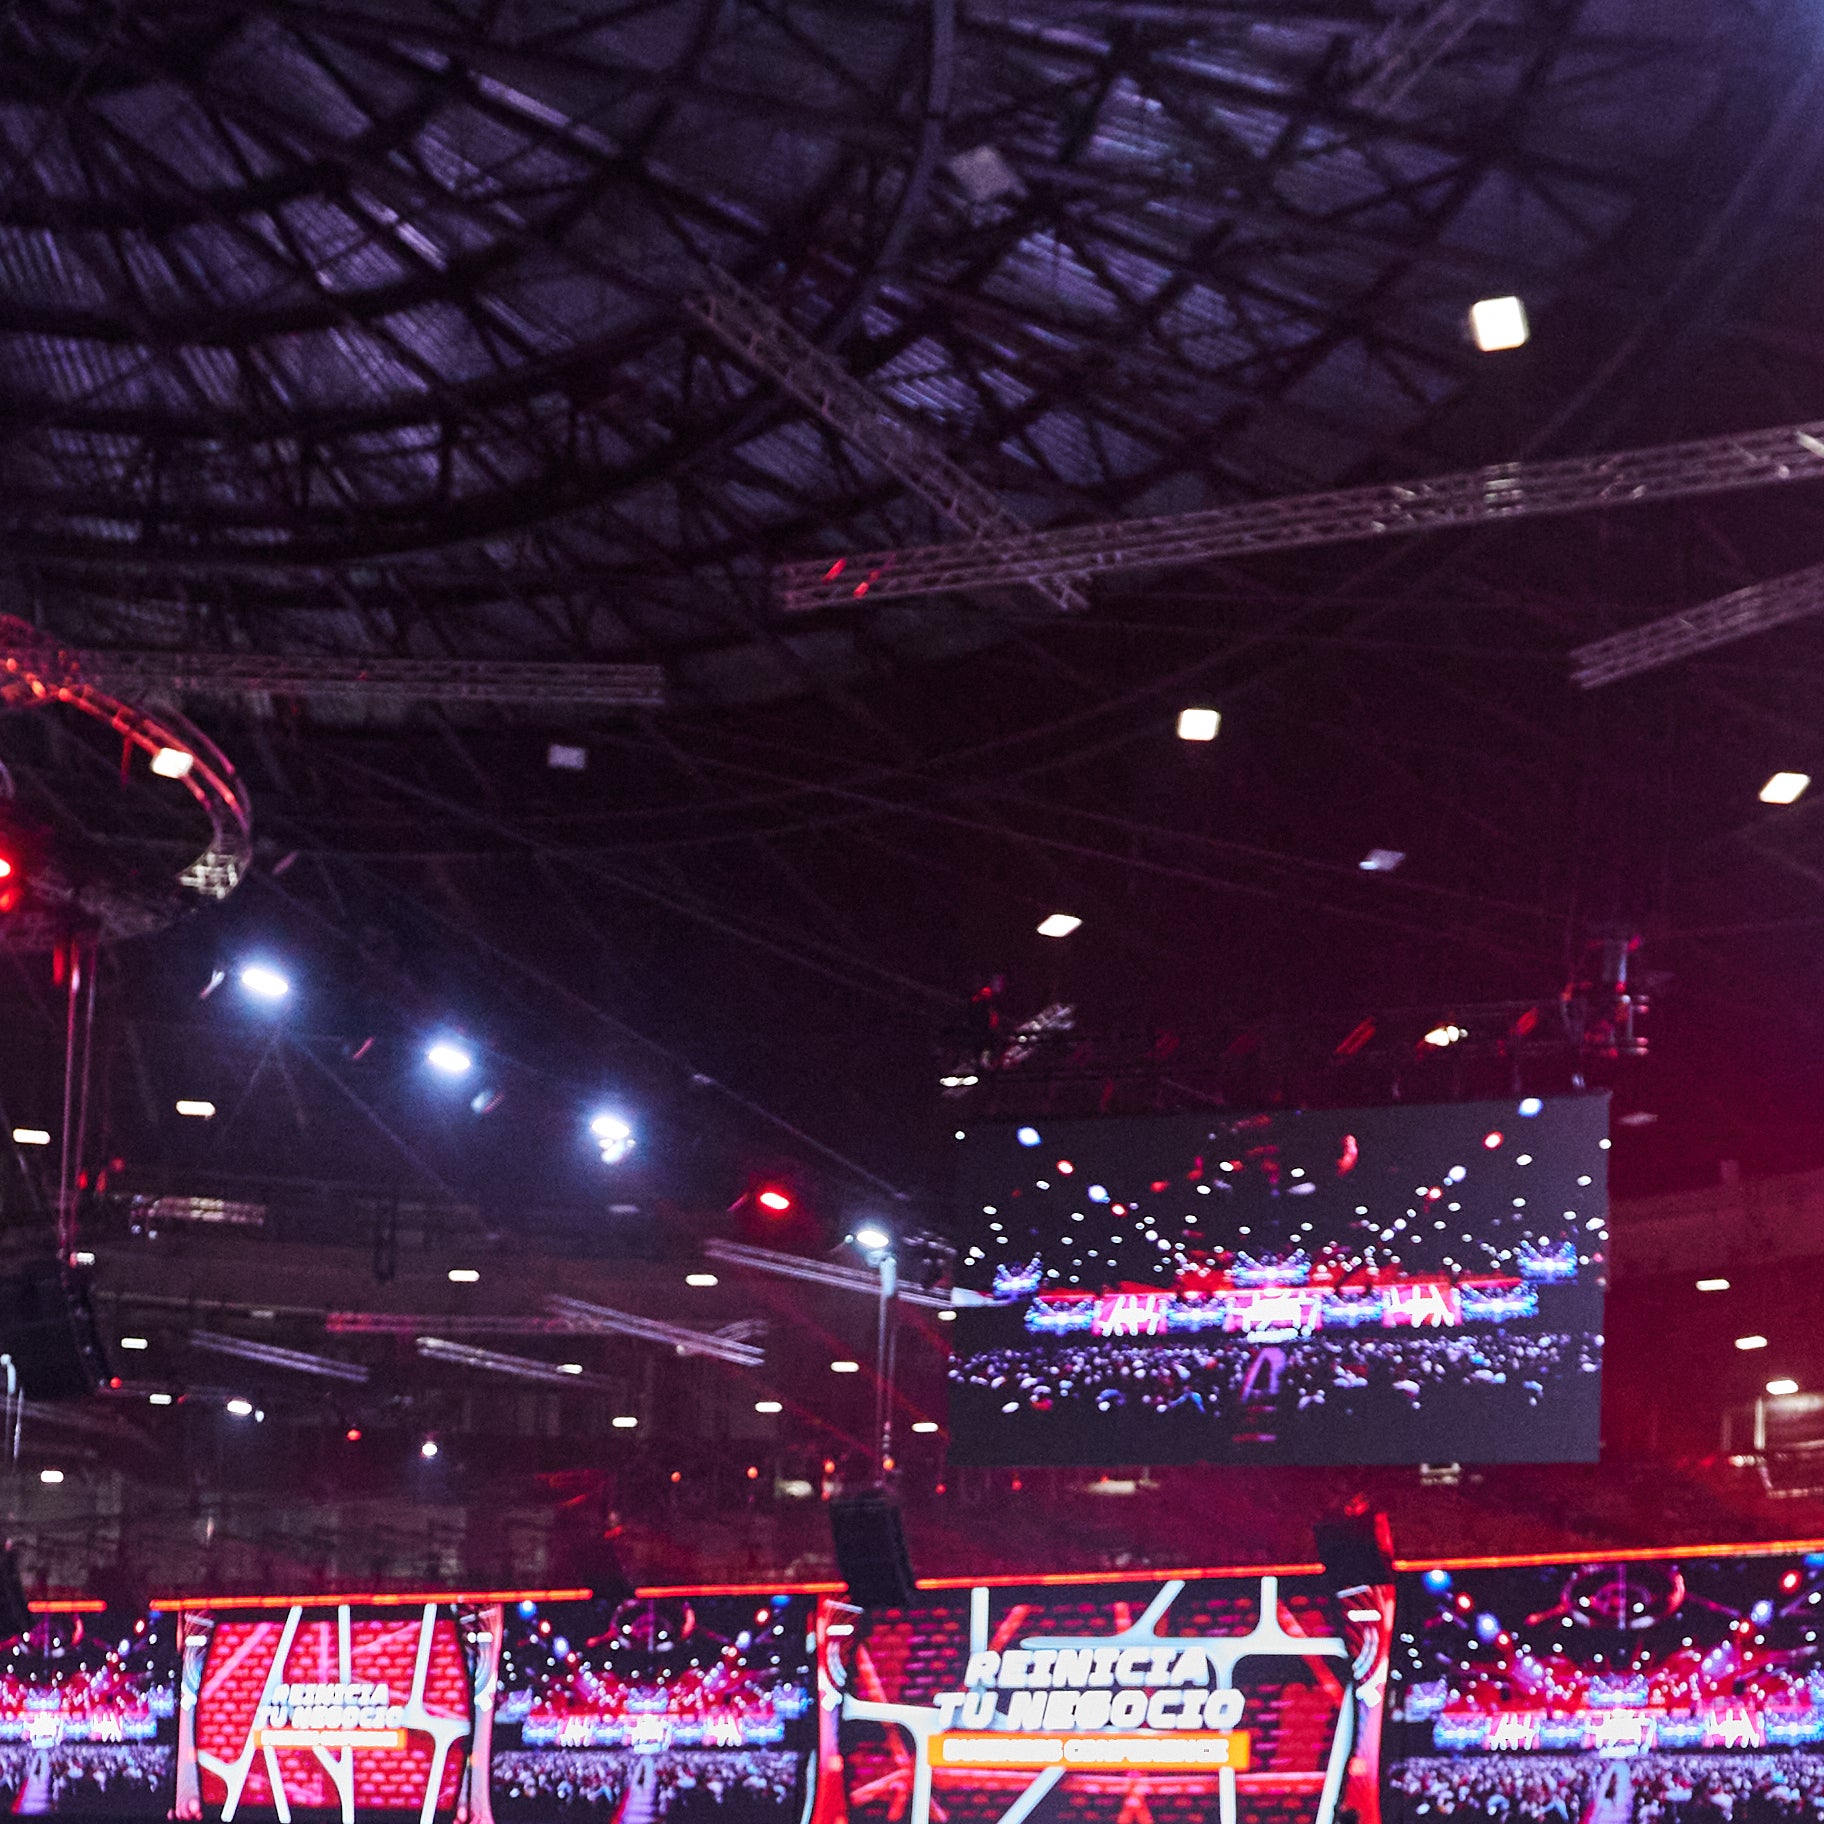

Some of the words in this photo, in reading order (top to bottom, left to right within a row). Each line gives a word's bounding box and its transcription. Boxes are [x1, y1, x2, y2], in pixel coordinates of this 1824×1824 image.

[964, 1647, 1209, 1687] REINICIA
[933, 1691, 998, 1731] TU
[1006, 1688, 1245, 1730] NEGOCIO
